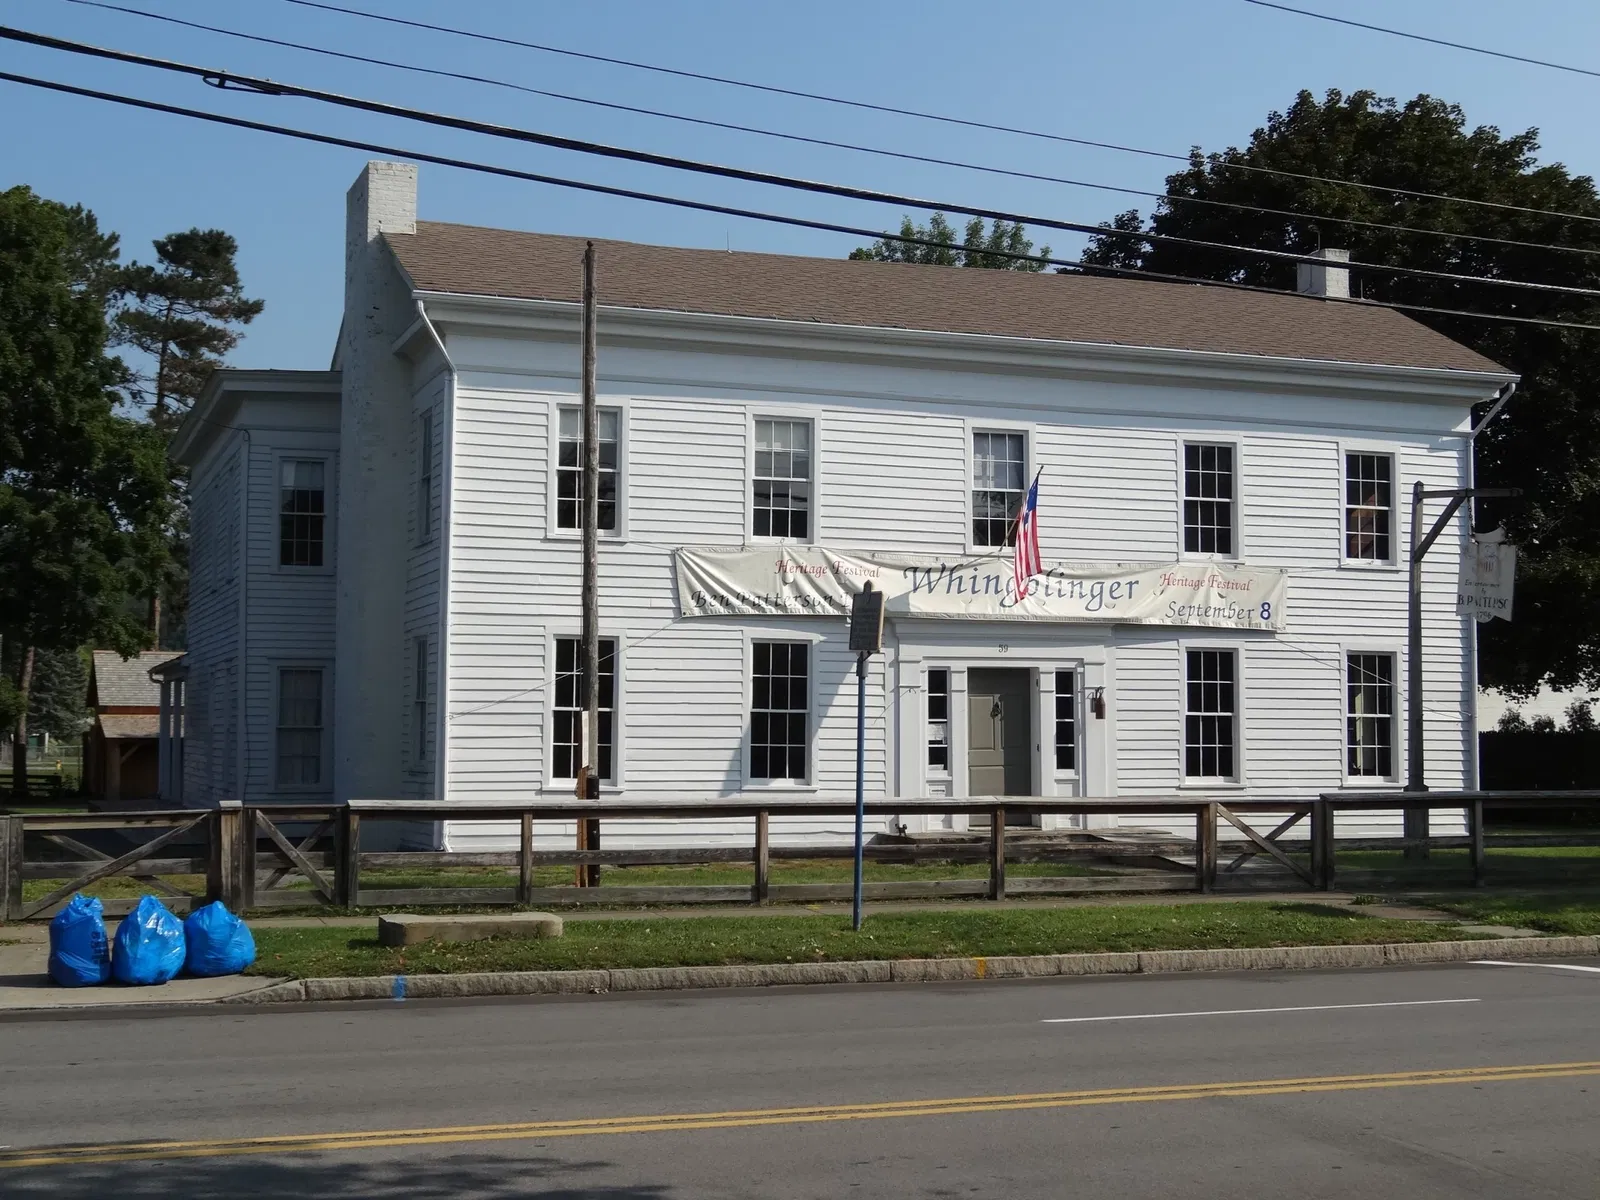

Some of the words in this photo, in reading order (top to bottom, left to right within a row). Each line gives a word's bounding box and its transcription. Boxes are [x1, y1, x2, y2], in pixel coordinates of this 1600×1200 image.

[774, 559, 828, 578] Heritage
[832, 560, 881, 578] Festival
[1159, 572, 1205, 591] Heritage
[1208, 574, 1253, 591] Festival
[691, 590, 732, 608] Ben
[736, 591, 837, 608] Patterson
[1165, 601, 1255, 624] September
[1260, 601, 1271, 621] 8
